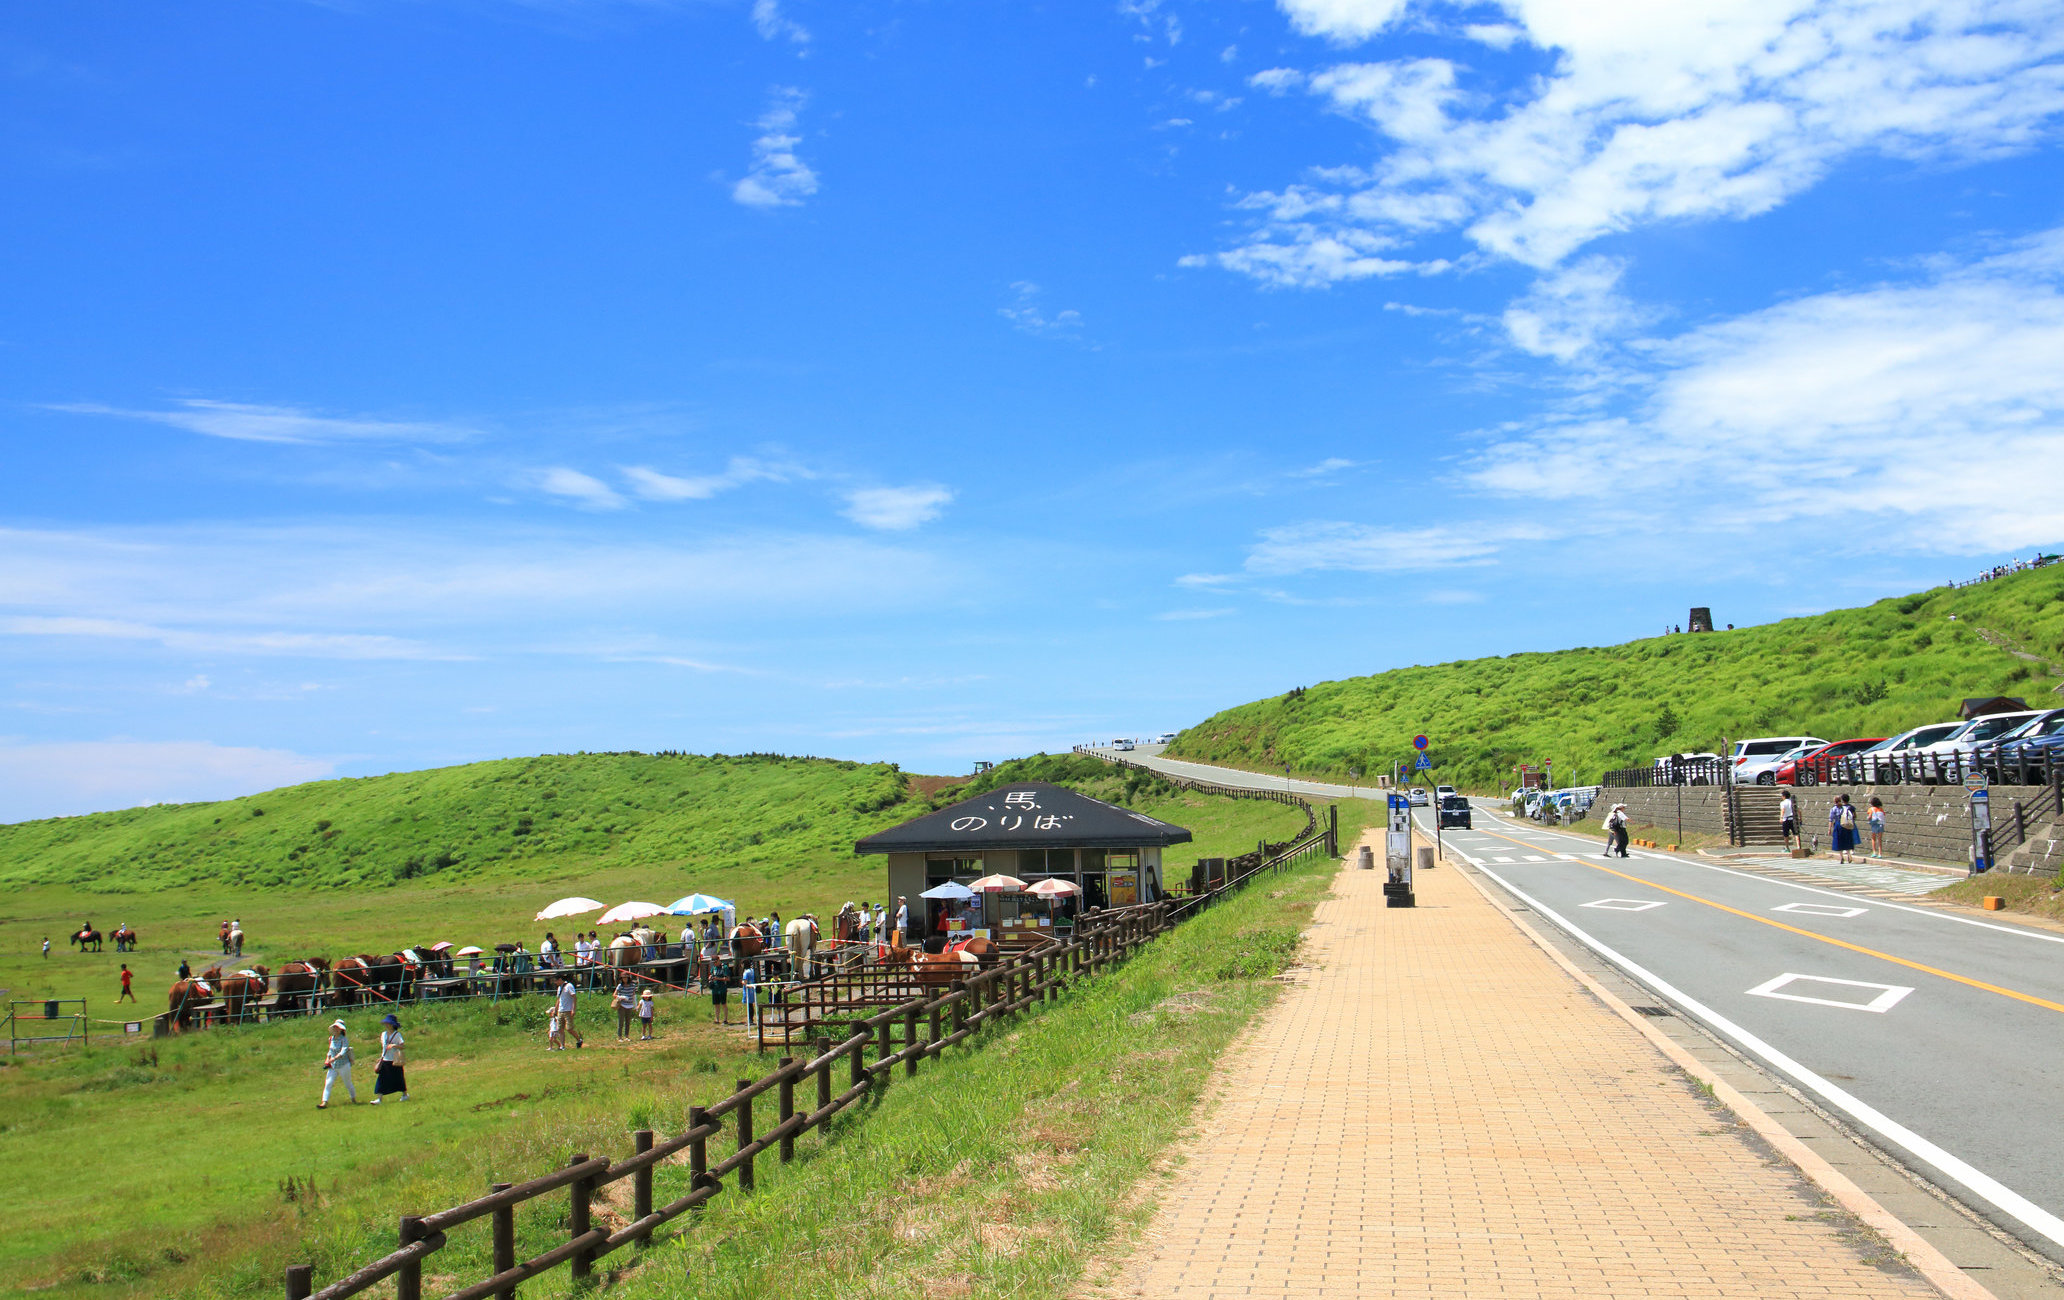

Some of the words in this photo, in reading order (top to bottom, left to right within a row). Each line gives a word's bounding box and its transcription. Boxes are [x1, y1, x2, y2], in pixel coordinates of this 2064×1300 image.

[988, 791, 1042, 811] 馬
[951, 814, 1074, 831] のりば
